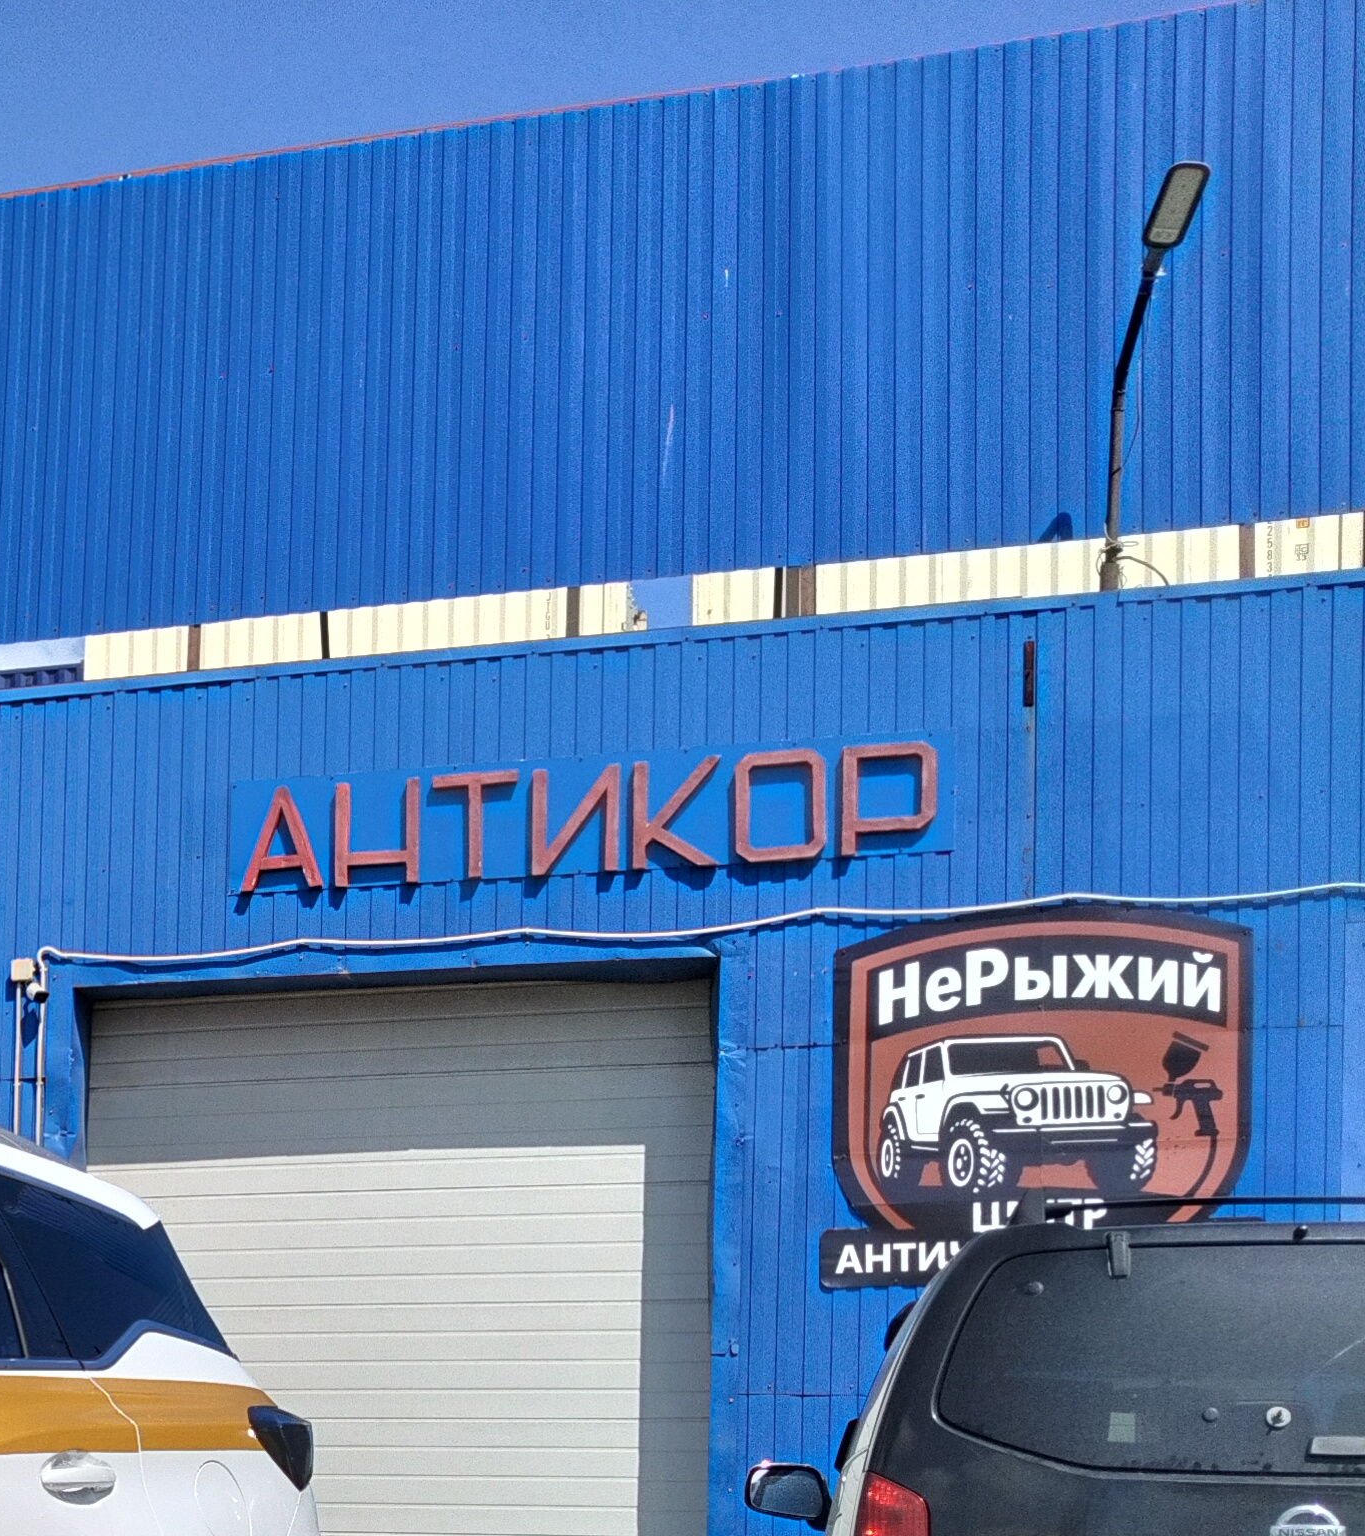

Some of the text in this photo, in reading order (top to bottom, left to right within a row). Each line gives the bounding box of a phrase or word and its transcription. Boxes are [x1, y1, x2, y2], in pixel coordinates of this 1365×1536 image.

[241, 741, 938, 893] АНТИКОР
[877, 947, 1222, 1026] НеРыжий
[835, 1241, 962, 1274] АНТИ
[1278, 1528, 1338, 1536] NISSAN
